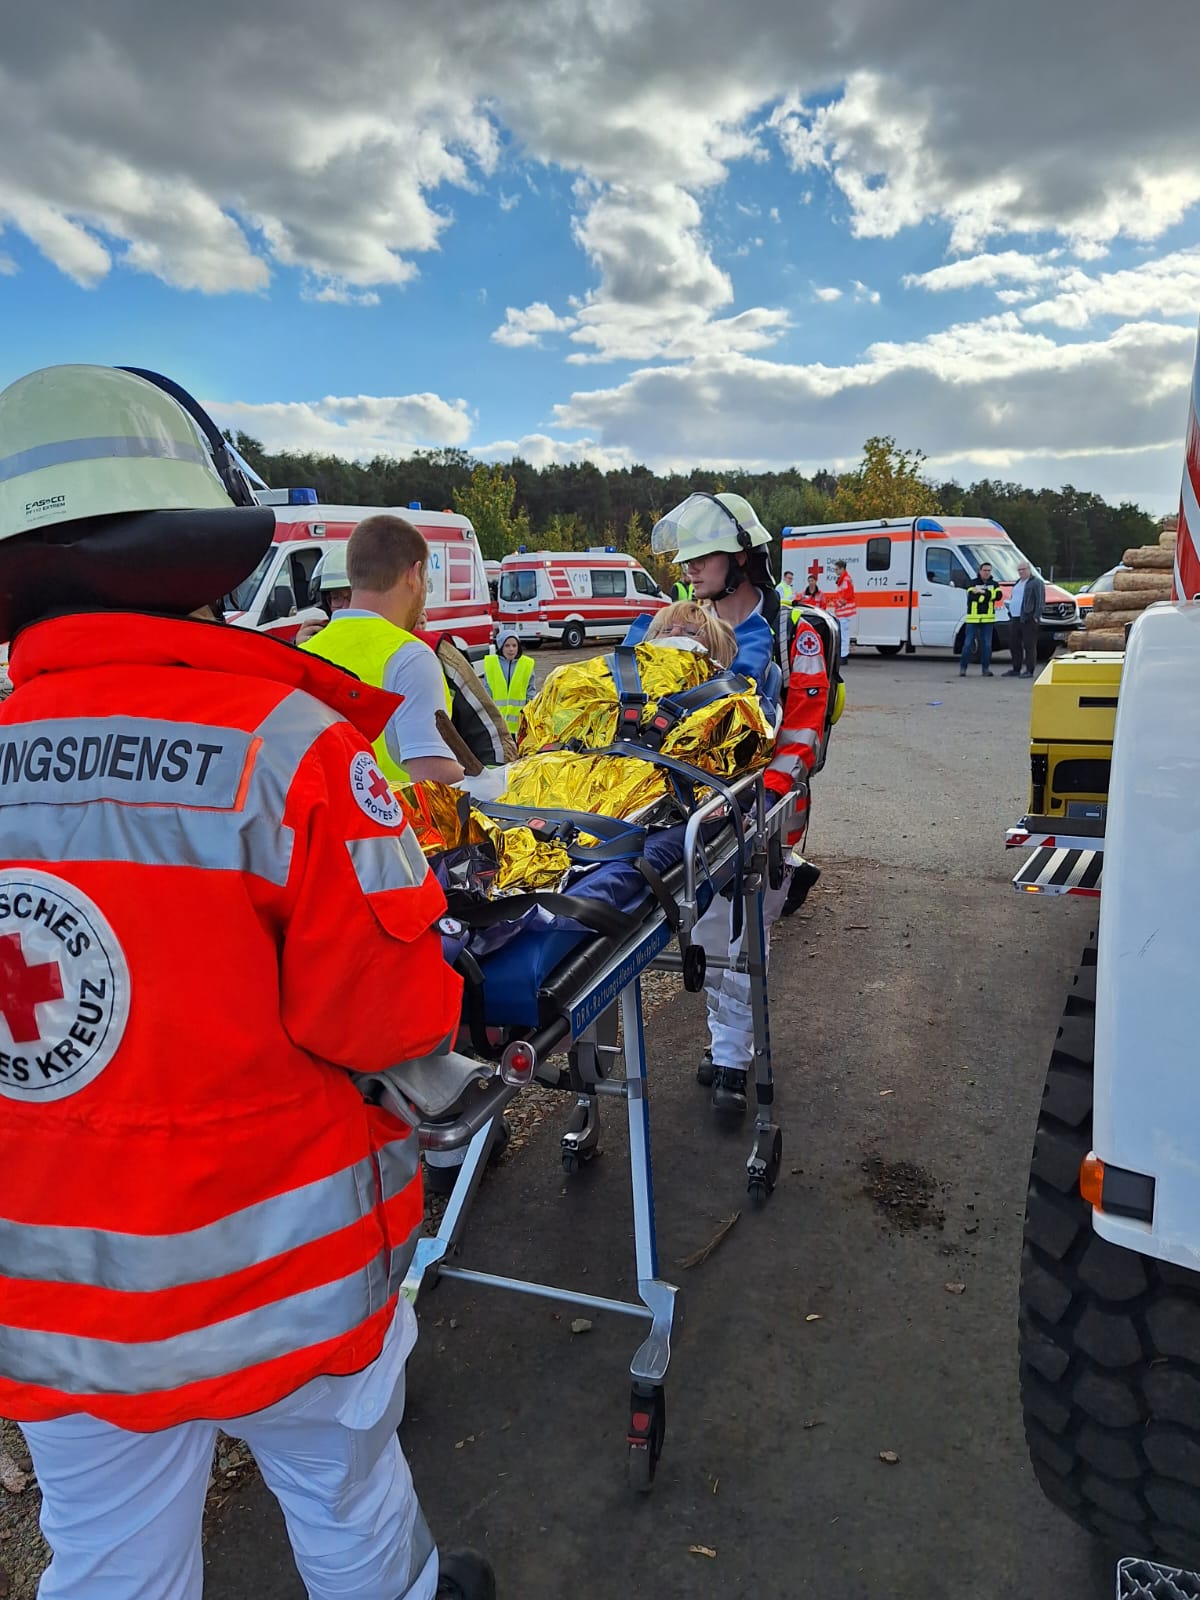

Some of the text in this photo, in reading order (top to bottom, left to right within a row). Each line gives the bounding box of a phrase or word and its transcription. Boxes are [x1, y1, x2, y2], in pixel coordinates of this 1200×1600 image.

[430, 553, 440, 569] 12
[874, 577, 888, 586] 112
[365, 798, 393, 820] ROTES
[35, 977, 106, 1079] KREUZ
